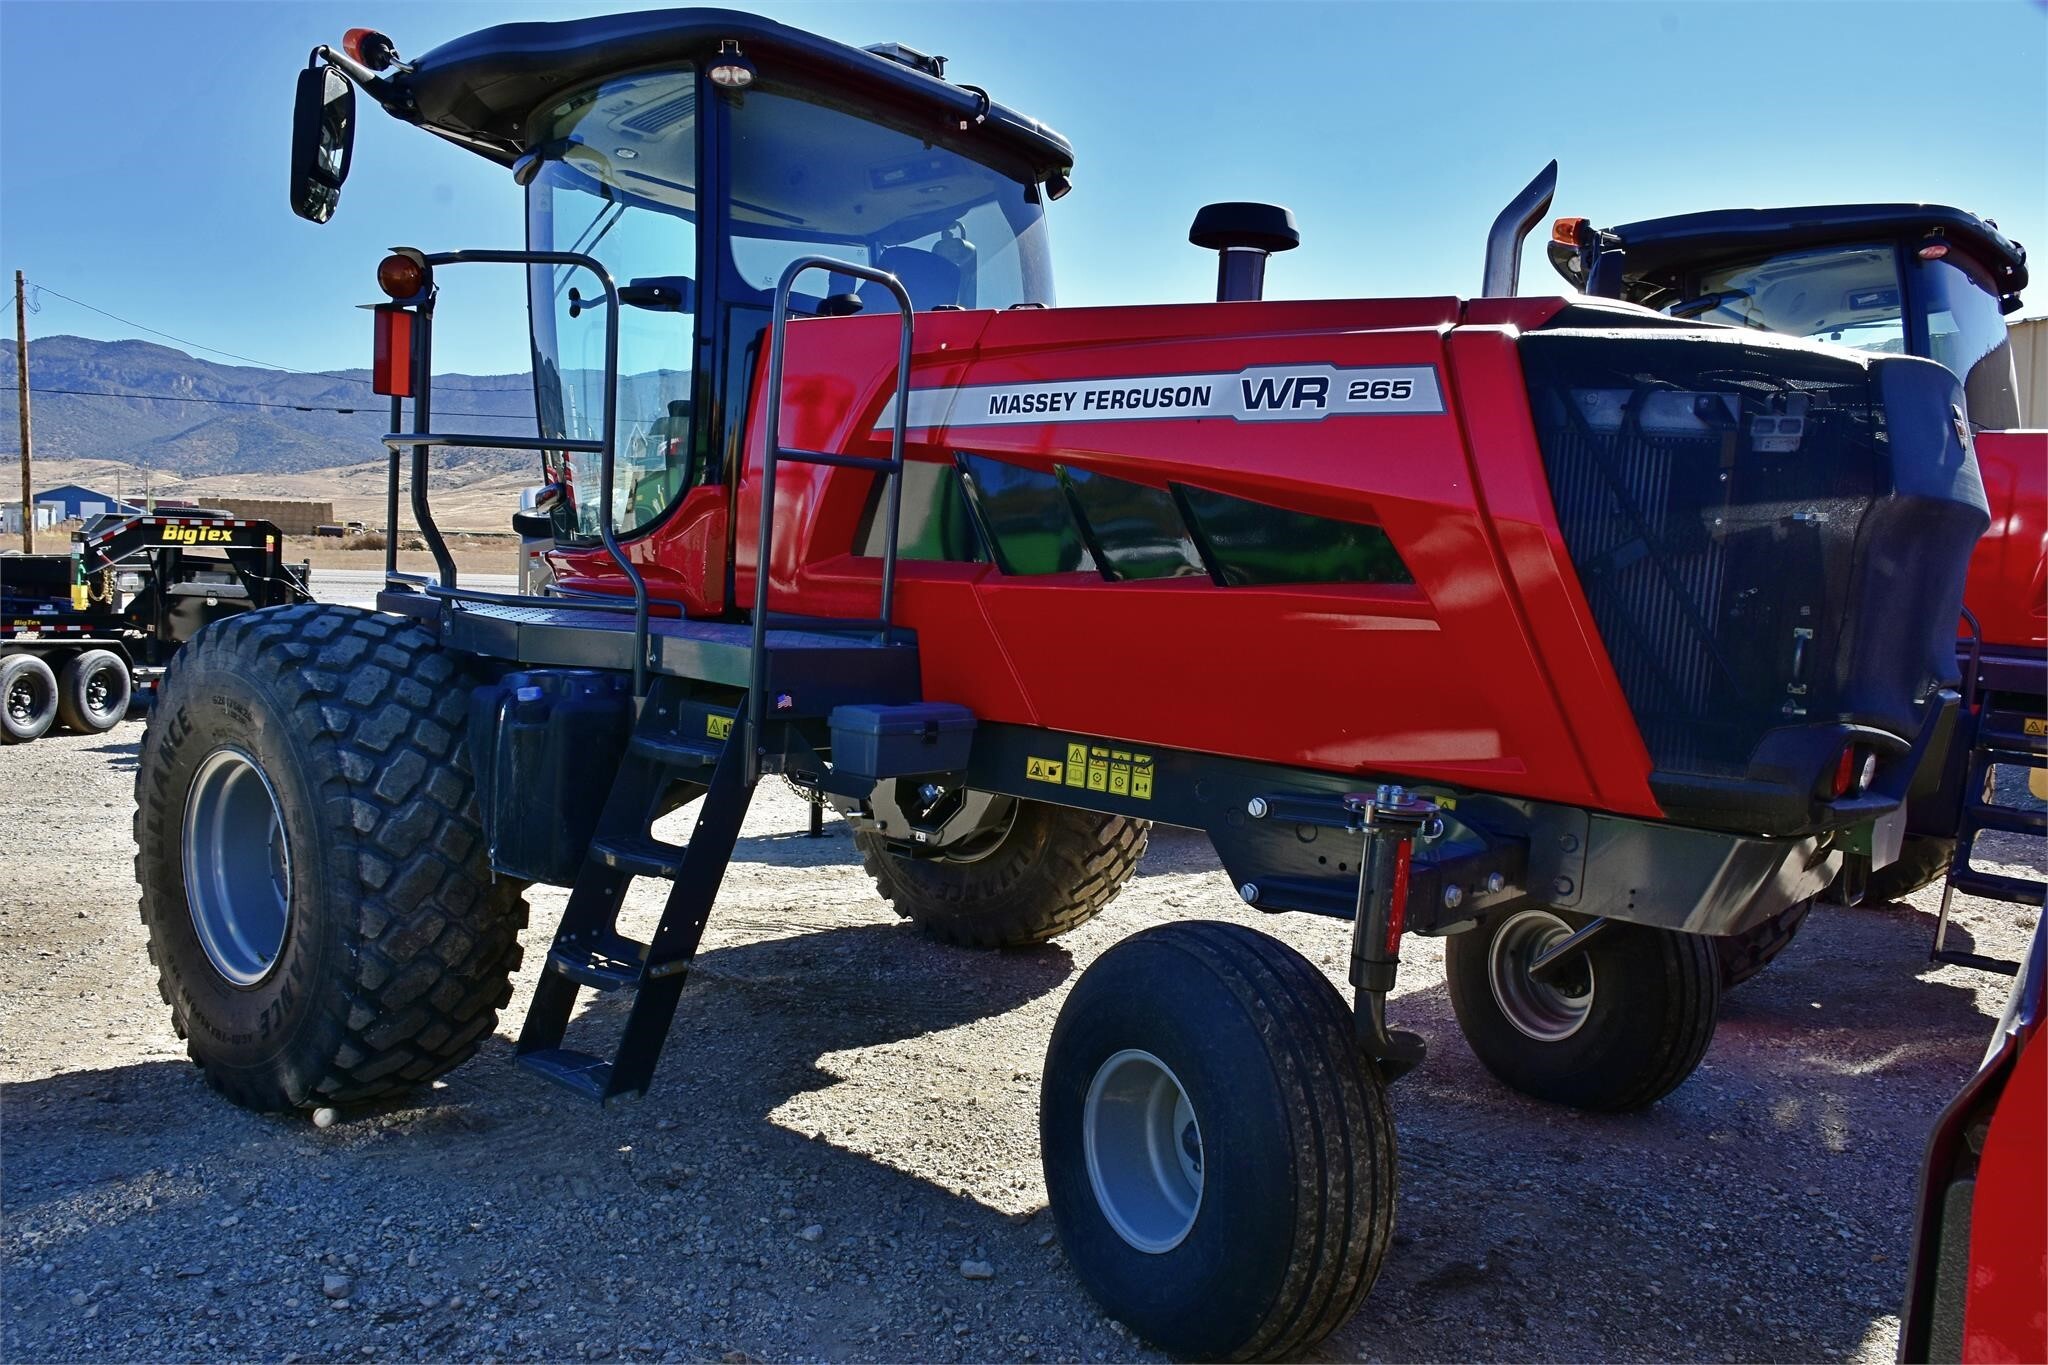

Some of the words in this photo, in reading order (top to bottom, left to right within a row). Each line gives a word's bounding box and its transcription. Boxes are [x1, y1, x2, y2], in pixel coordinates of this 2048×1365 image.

[988, 391, 1077, 415] MASSEY
[1083, 385, 1212, 411] FERGUSON
[1241, 376, 1330, 410] WR
[1348, 380, 1412, 400] 265
[162, 524, 233, 545] BigTex
